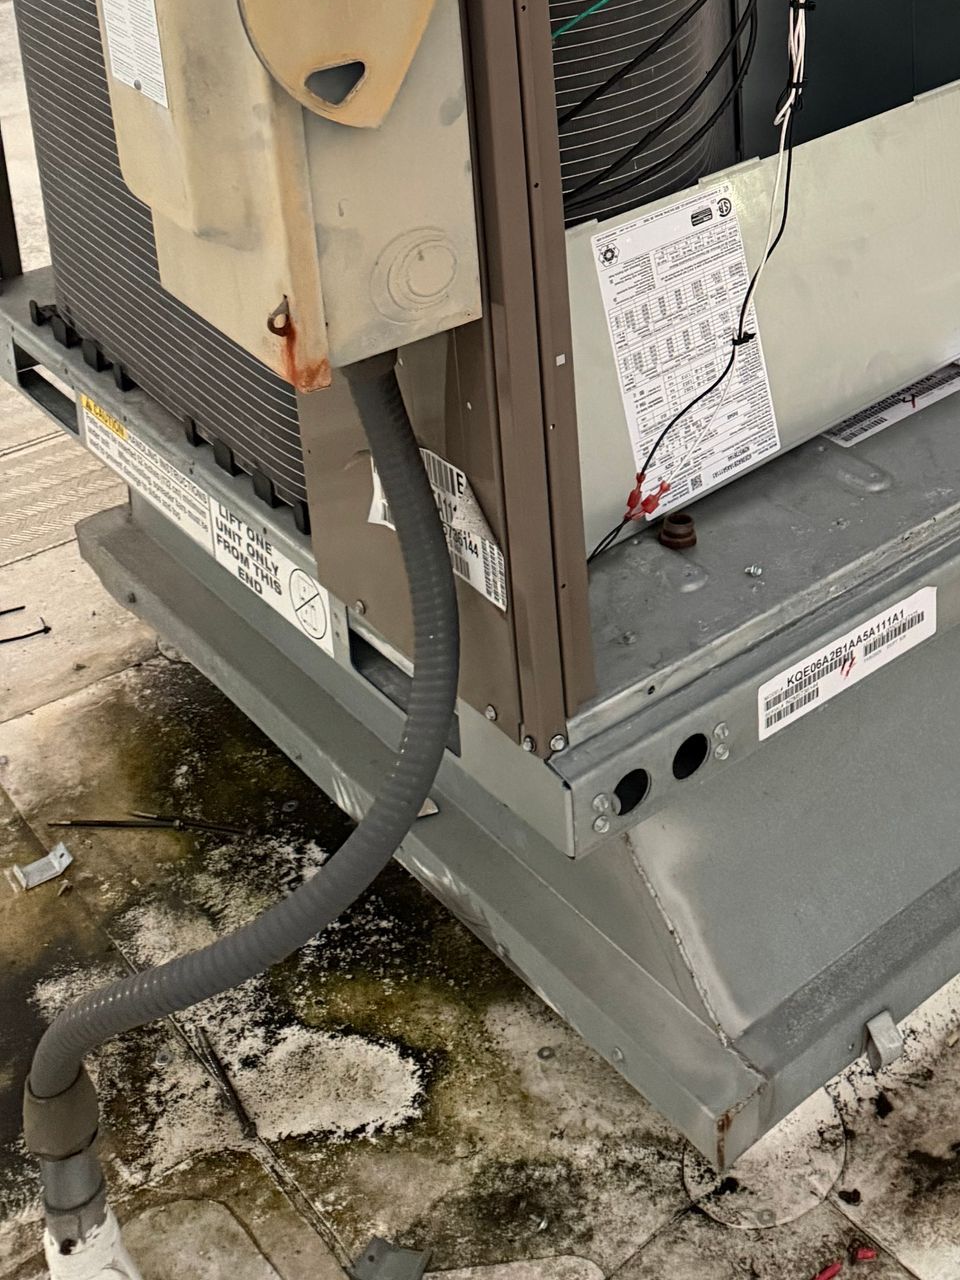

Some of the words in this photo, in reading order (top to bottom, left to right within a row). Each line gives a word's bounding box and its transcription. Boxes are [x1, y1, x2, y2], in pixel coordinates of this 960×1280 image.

[215, 515, 243, 549] UNIT
[246, 540, 279, 578] ONLY
[218, 503, 242, 533] LIFT
[245, 524, 272, 556] ONE
[216, 532, 250, 571] FROM
[252, 561, 282, 597] THIS
[237, 564, 262, 596] END
[787, 608, 904, 688] KQE06A2B1AA5A111A1
